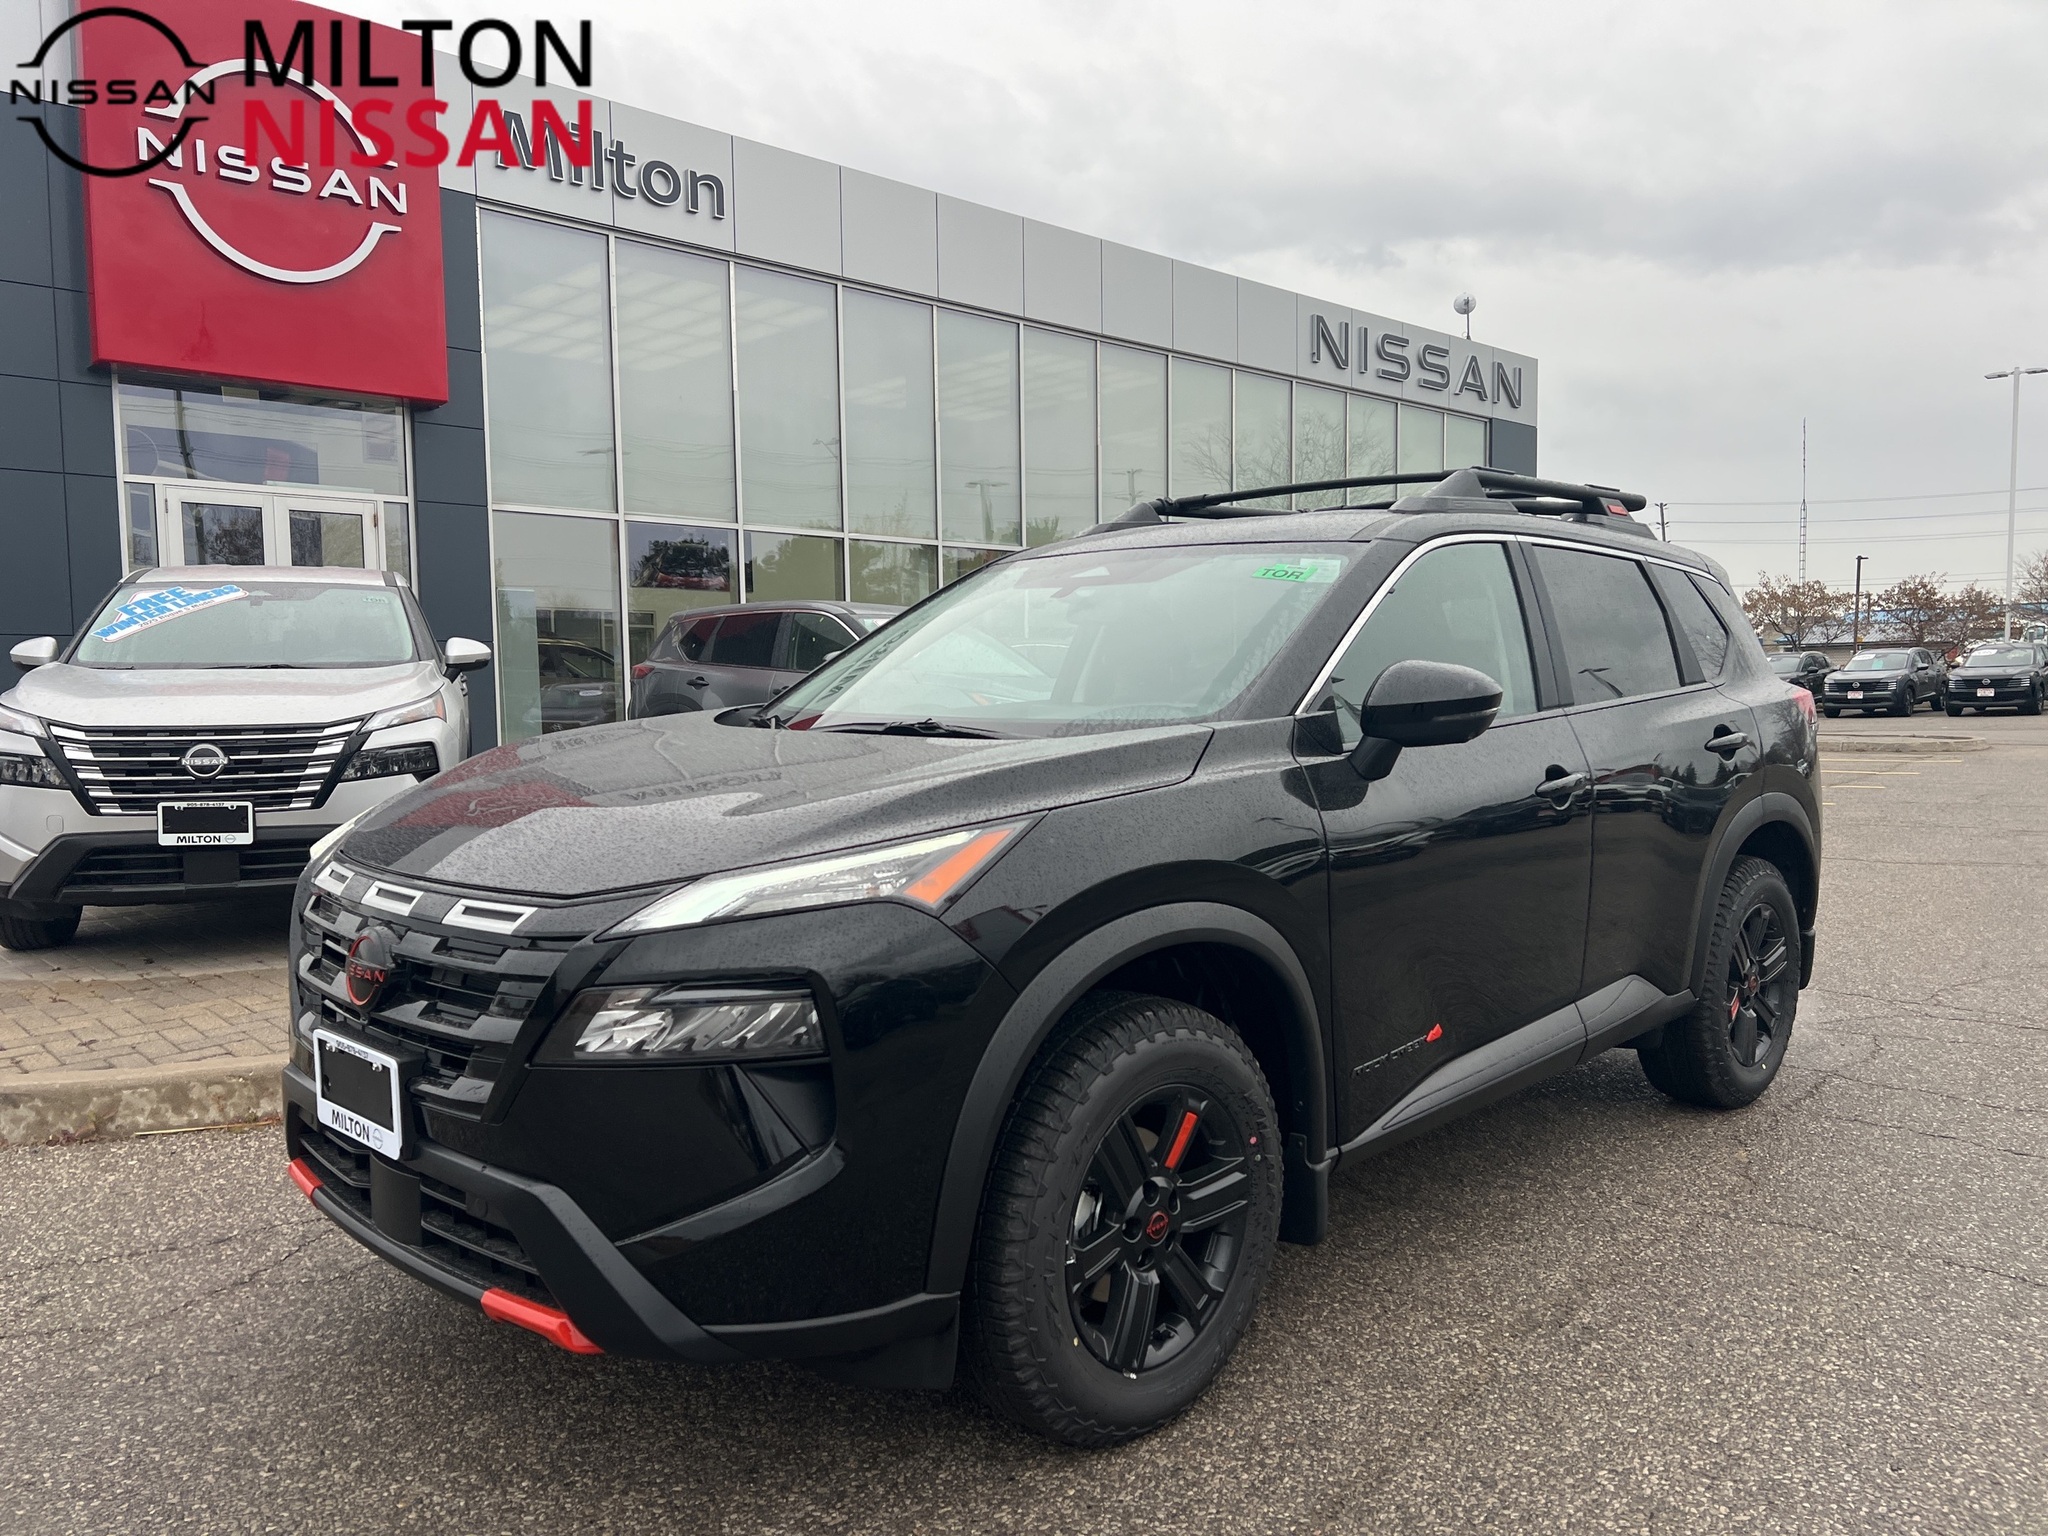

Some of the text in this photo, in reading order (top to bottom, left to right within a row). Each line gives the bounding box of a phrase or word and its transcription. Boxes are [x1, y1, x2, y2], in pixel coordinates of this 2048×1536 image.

[136, 126, 408, 215] NISSAN
[1311, 313, 1522, 409] NISSAN
[1261, 568, 1304, 580] TOR
[116, 586, 194, 616] FREE
[93, 603, 174, 638] WINTER
[182, 757, 228, 766] NISSAN
[176, 835, 221, 844] MILTON
[331, 1109, 370, 1143] MILTON
